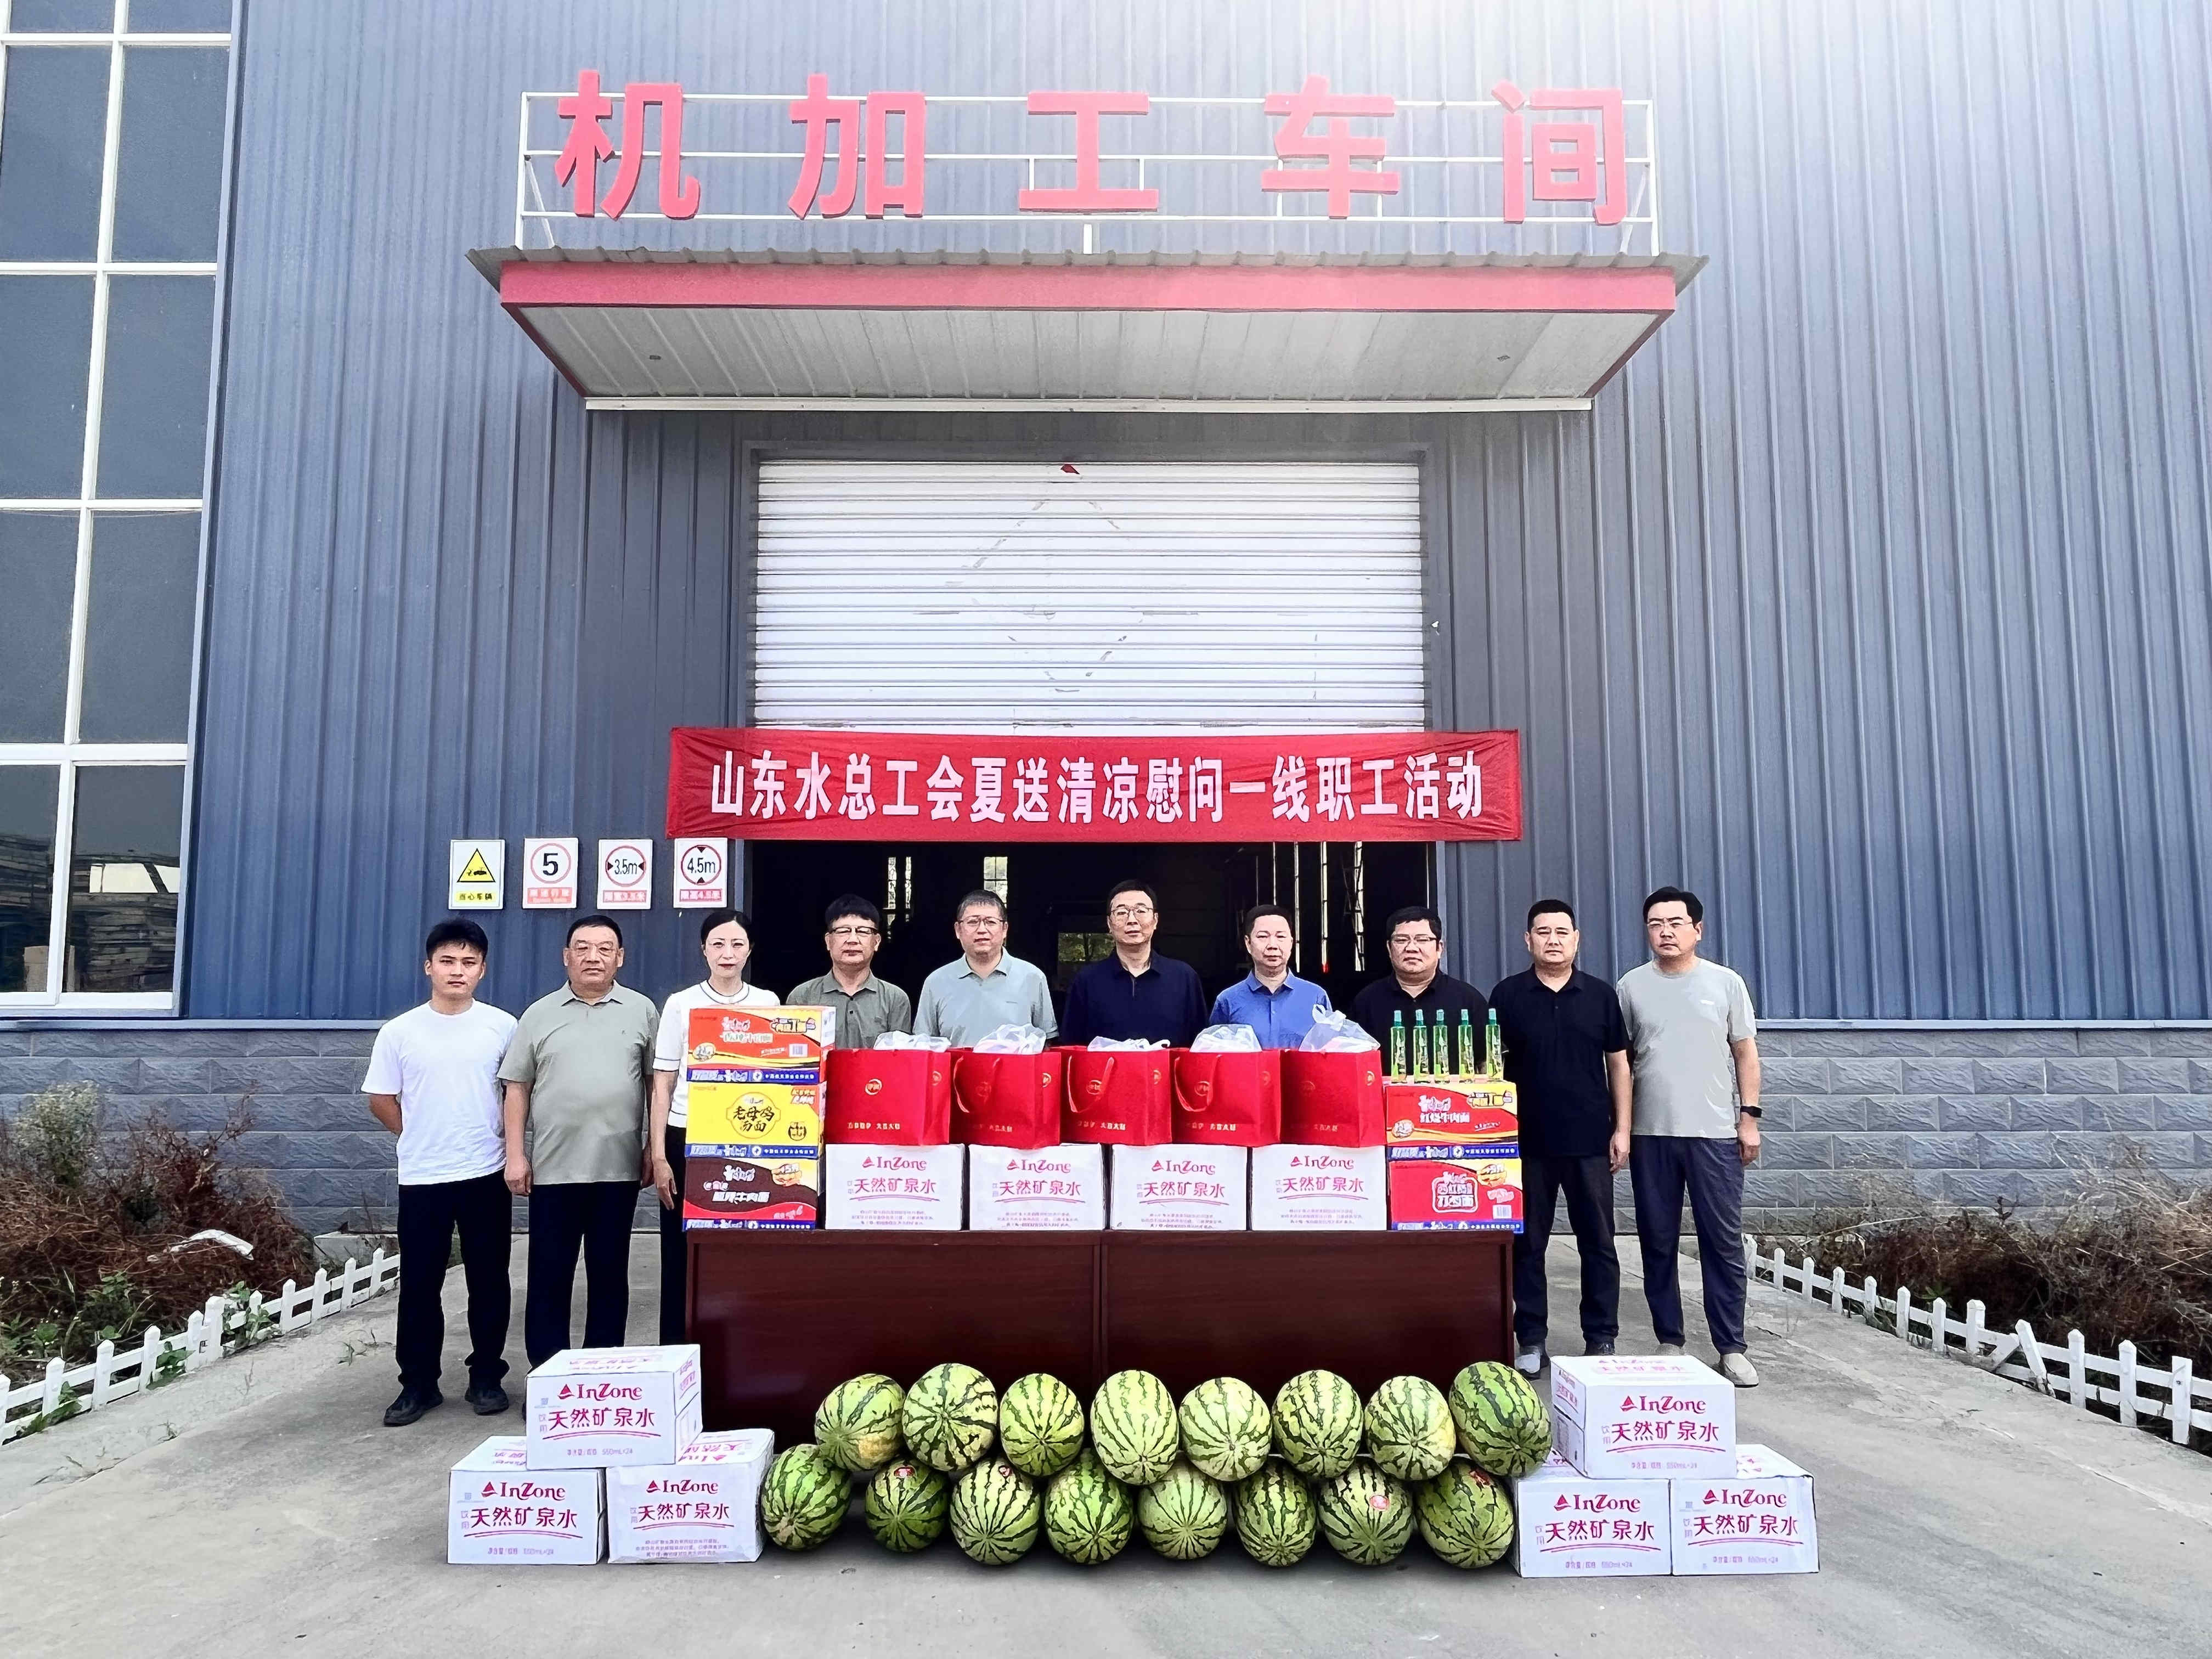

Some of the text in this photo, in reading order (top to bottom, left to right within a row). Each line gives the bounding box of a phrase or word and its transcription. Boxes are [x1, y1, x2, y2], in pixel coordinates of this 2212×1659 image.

[555, 70, 1626, 225] 机加工车间
[712, 749, 1482, 823] 山东水总工会夏送清凉慰问一线职工活动
[542, 853, 558, 876] 5
[614, 859, 637, 875] 3.5m
[687, 856, 716, 873] 4.5m
[877, 1156, 927, 1171] InZone
[1022, 1159, 1071, 1173] InZone
[1166, 1160, 1216, 1176] InZone
[1305, 1155, 1355, 1170] InZone
[854, 1177, 936, 1194] 天然矿泉水
[1000, 1180, 1081, 1197] 天然矿泉水
[1144, 1181, 1226, 1199] 天然矿泉水
[1283, 1176, 1364, 1193] 天然矿泉水
[577, 1383, 643, 1402] InZone
[1639, 1395, 1707, 1414] InZone
[548, 1407, 656, 1431] 天然矿泉水
[1611, 1420, 1720, 1444] 天然矿泉水
[500, 1482, 566, 1501] InZone
[663, 1479, 719, 1495] InZone
[1573, 1494, 1641, 1513] InZone
[1722, 1489, 1787, 1508] InZone
[470, 1506, 578, 1529] 天然矿泉水
[638, 1503, 730, 1523] 天然矿泉水
[1545, 1519, 1655, 1544] 天然矿泉水
[1694, 1514, 1799, 1537] 天然矿泉水
